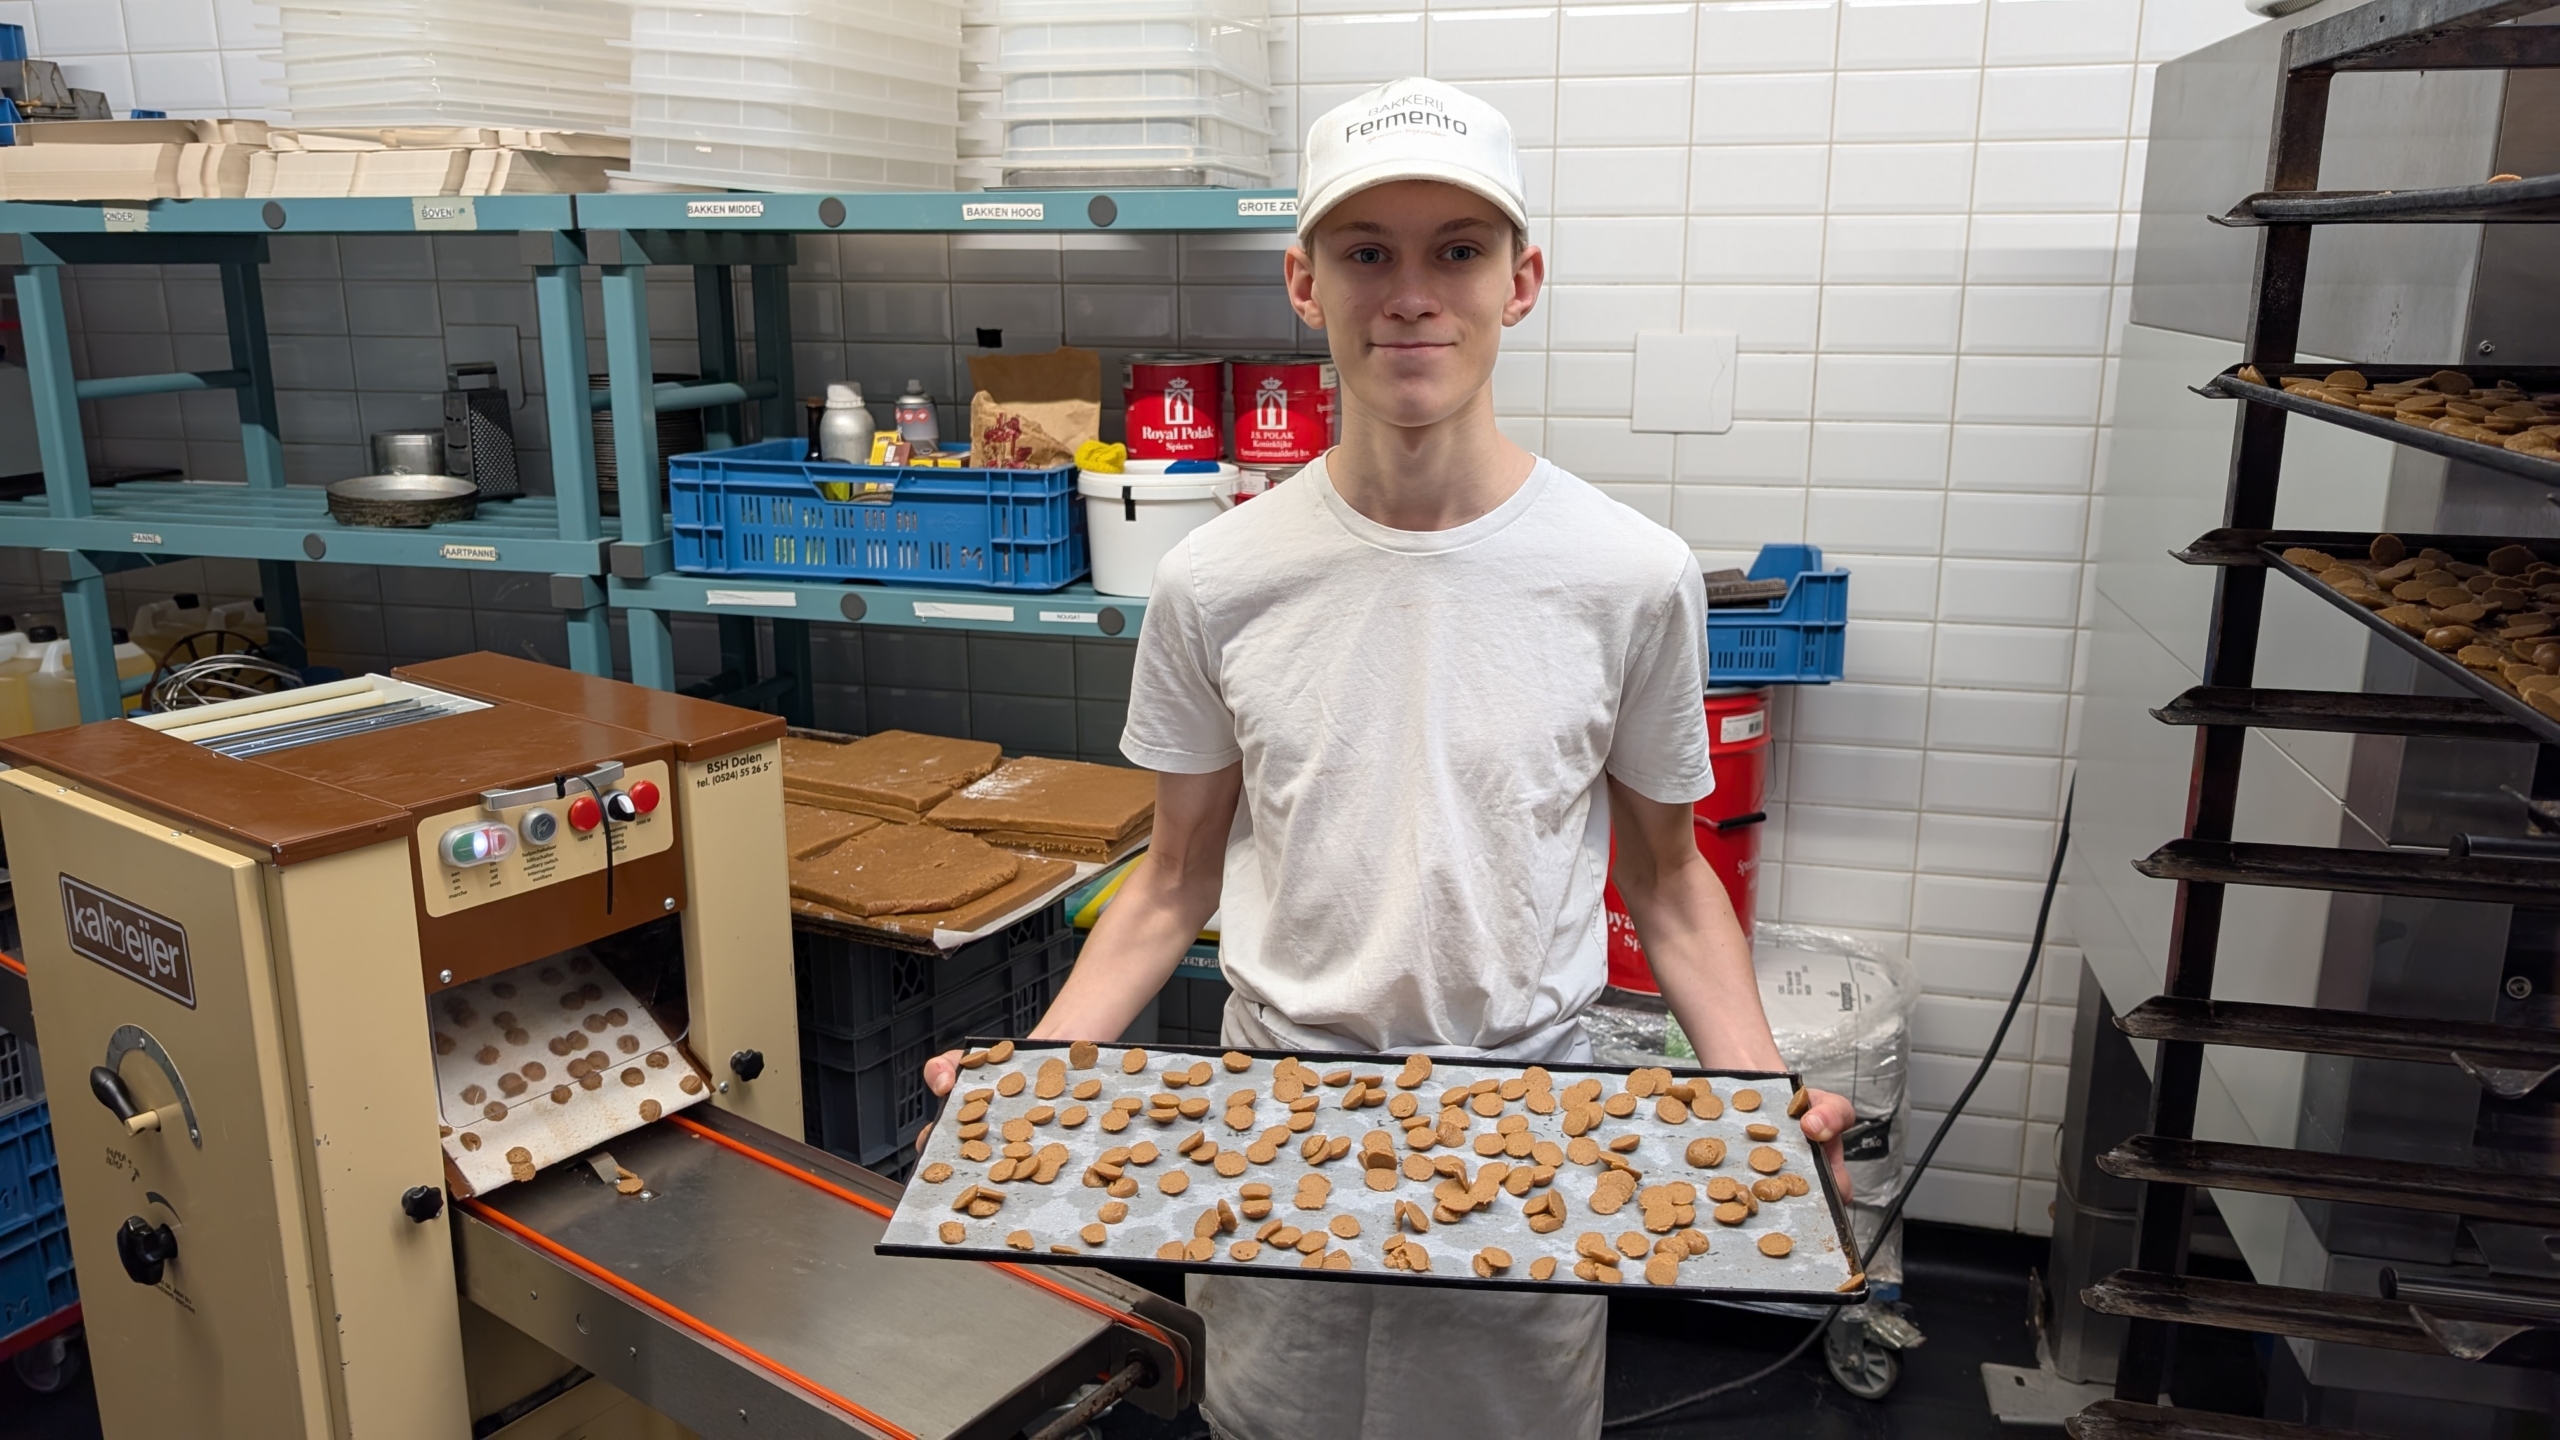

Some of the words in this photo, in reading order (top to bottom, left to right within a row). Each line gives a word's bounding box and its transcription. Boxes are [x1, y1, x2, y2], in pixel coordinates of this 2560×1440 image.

[1368, 94, 1444, 117] BAKKERIJ
[1346, 110, 1467, 143] Fermento
[687, 205, 725, 214] BAKKEN
[728, 205, 762, 214] MIDDEL
[966, 207, 1008, 217] BAKKEN
[1011, 208, 1042, 217] HOOG
[1239, 202, 1277, 212] GROTE
[105, 212, 133, 221] ONDER
[1142, 426, 1178, 443] Royal
[1181, 426, 1214, 440] Polak
[1263, 431, 1294, 440] POLAK
[1165, 442, 1194, 453] Spices
[1252, 440, 1292, 449] Koninklijke
[707, 759, 729, 774] BSH
[732, 753, 762, 768] Dalen
[697, 777, 710, 788] tel.
[712, 770, 738, 786] (0524)
[740, 767, 749, 777] 55
[751, 764, 761, 774] 26
